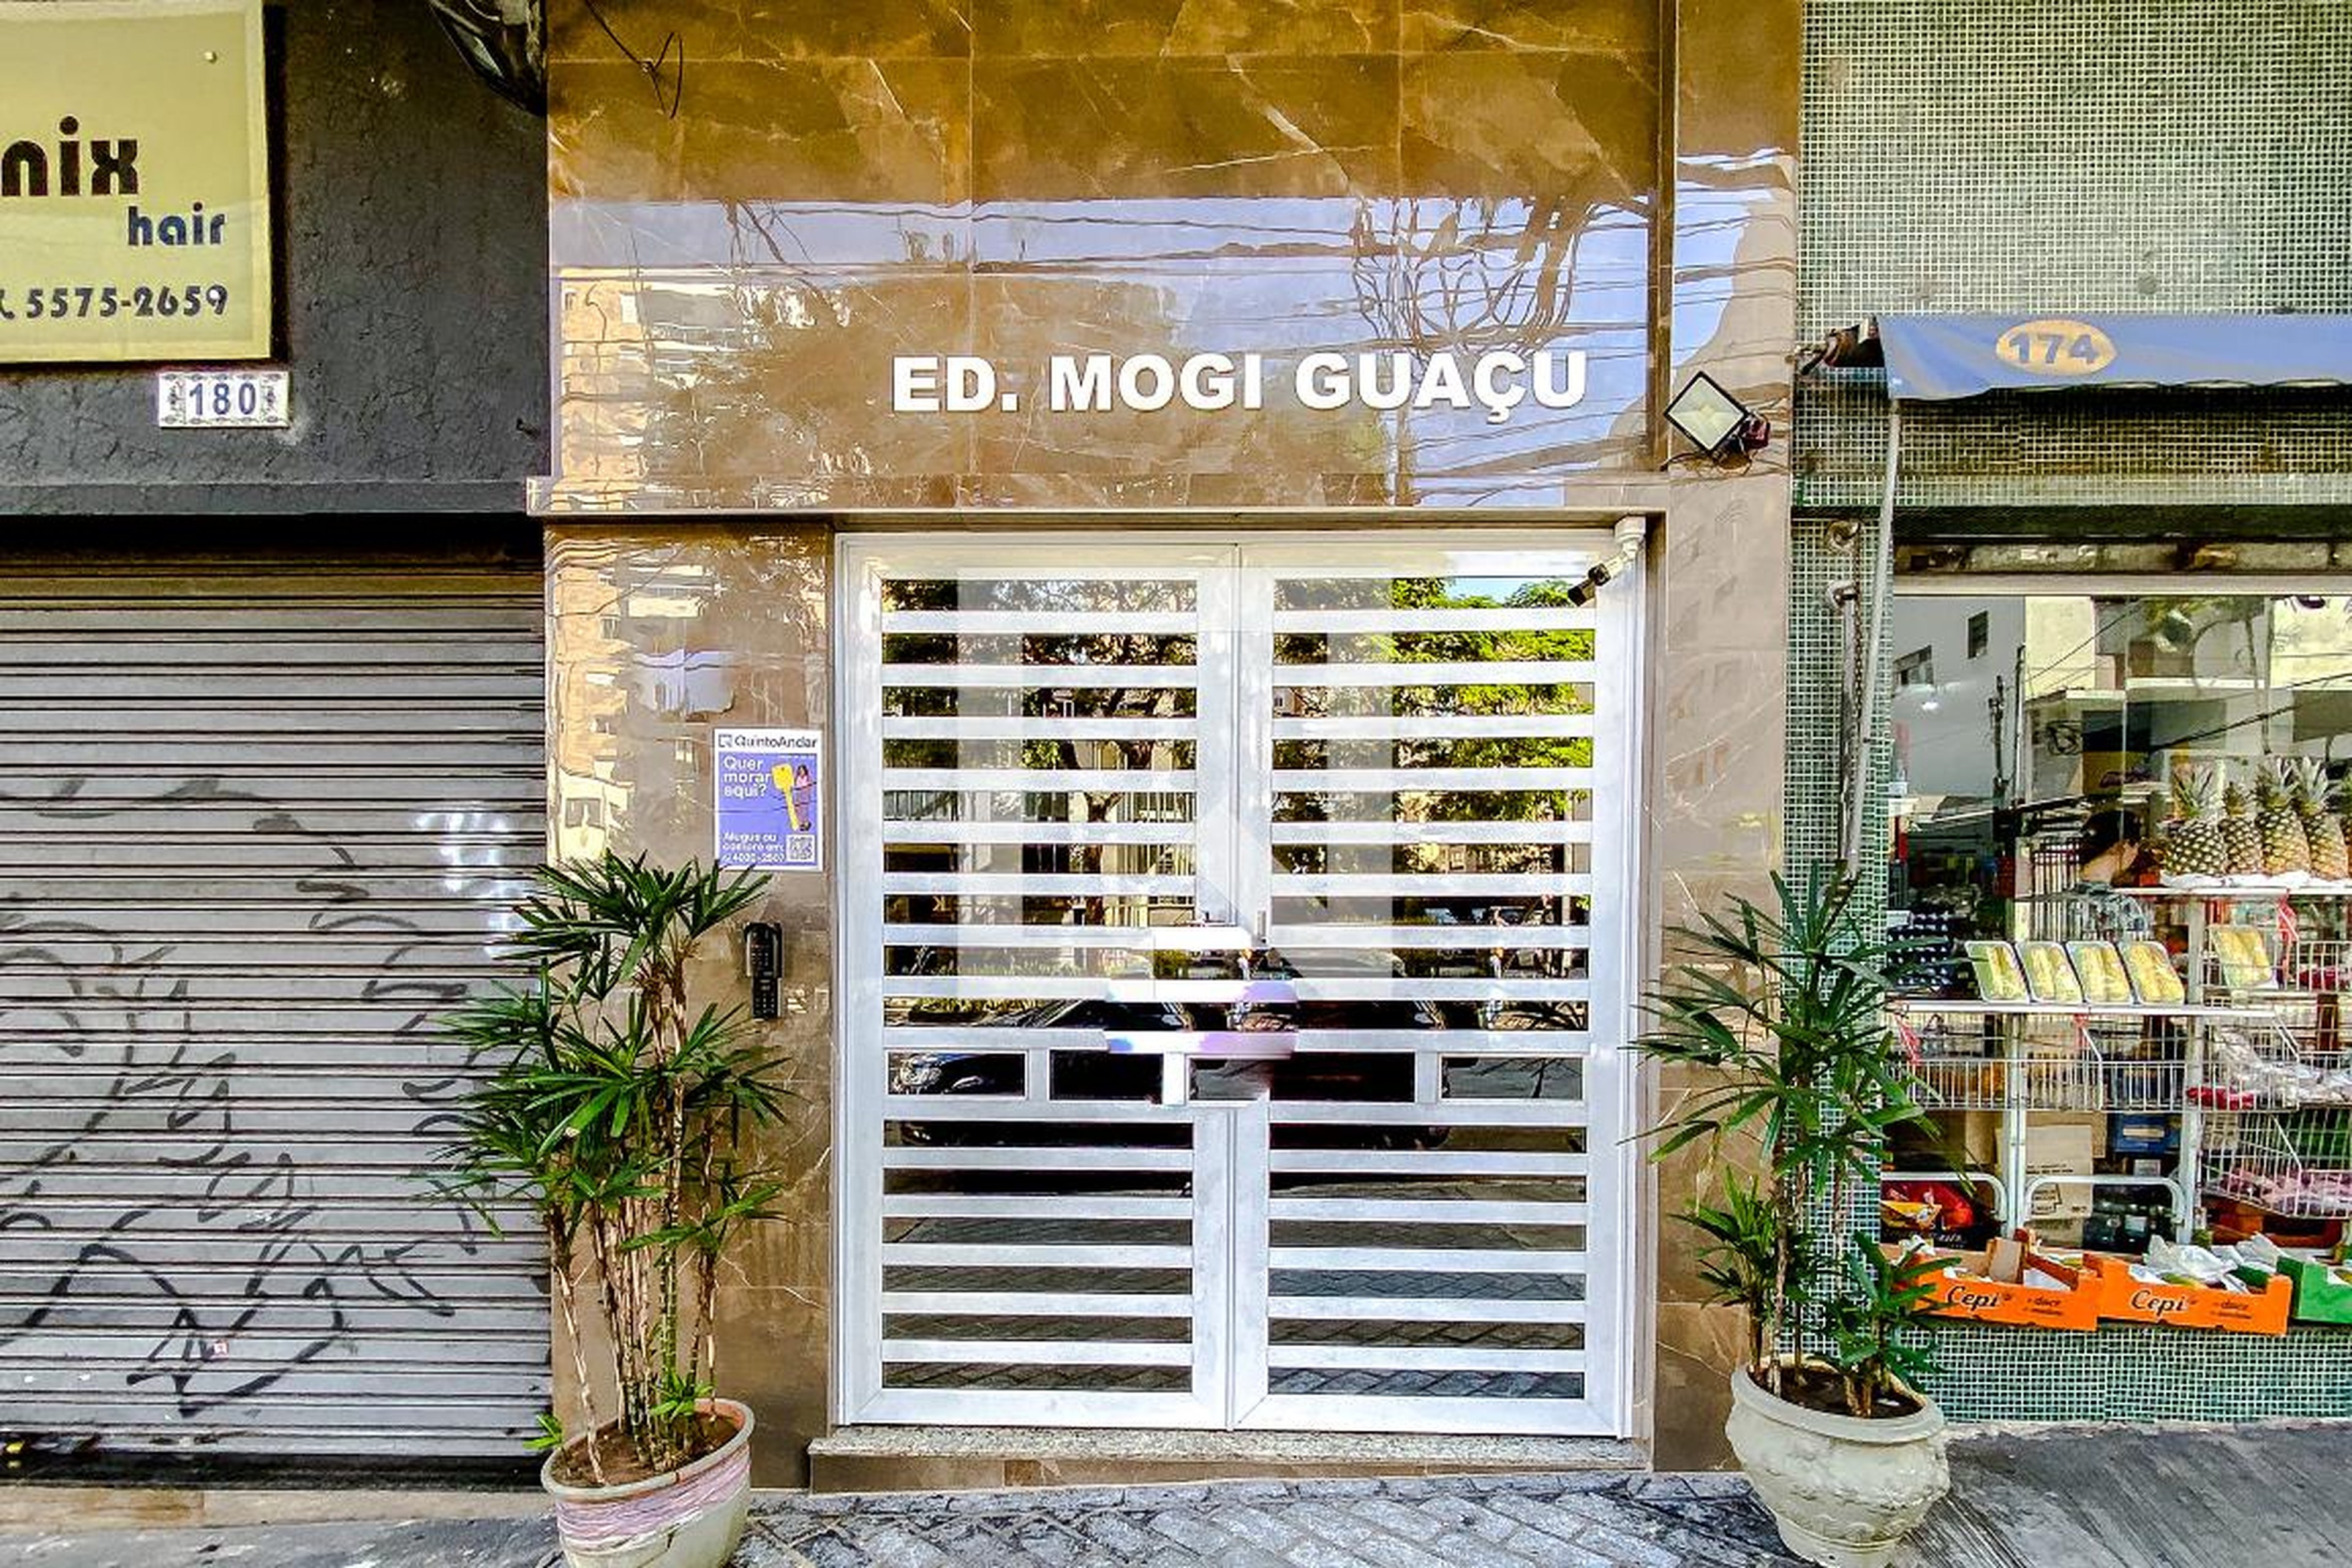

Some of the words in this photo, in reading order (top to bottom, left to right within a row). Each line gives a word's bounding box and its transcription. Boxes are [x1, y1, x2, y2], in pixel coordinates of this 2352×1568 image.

[127, 202, 226, 246] hair
[26, 284, 228, 318] 5575-2659
[2009, 334, 2100, 364] 174
[189, 382, 257, 415] 180
[892, 356, 1020, 412] ED.
[1050, 353, 1262, 412] MOGI
[1295, 352, 1588, 423] GUAÇU
[734, 735, 818, 748] QuintoAndar
[724, 755, 764, 771] Quer
[724, 773, 772, 783] morar
[724, 783, 767, 799] aqui?
[1947, 1286, 1999, 1311] Cepi
[2130, 1289, 2190, 1317] Cepi
